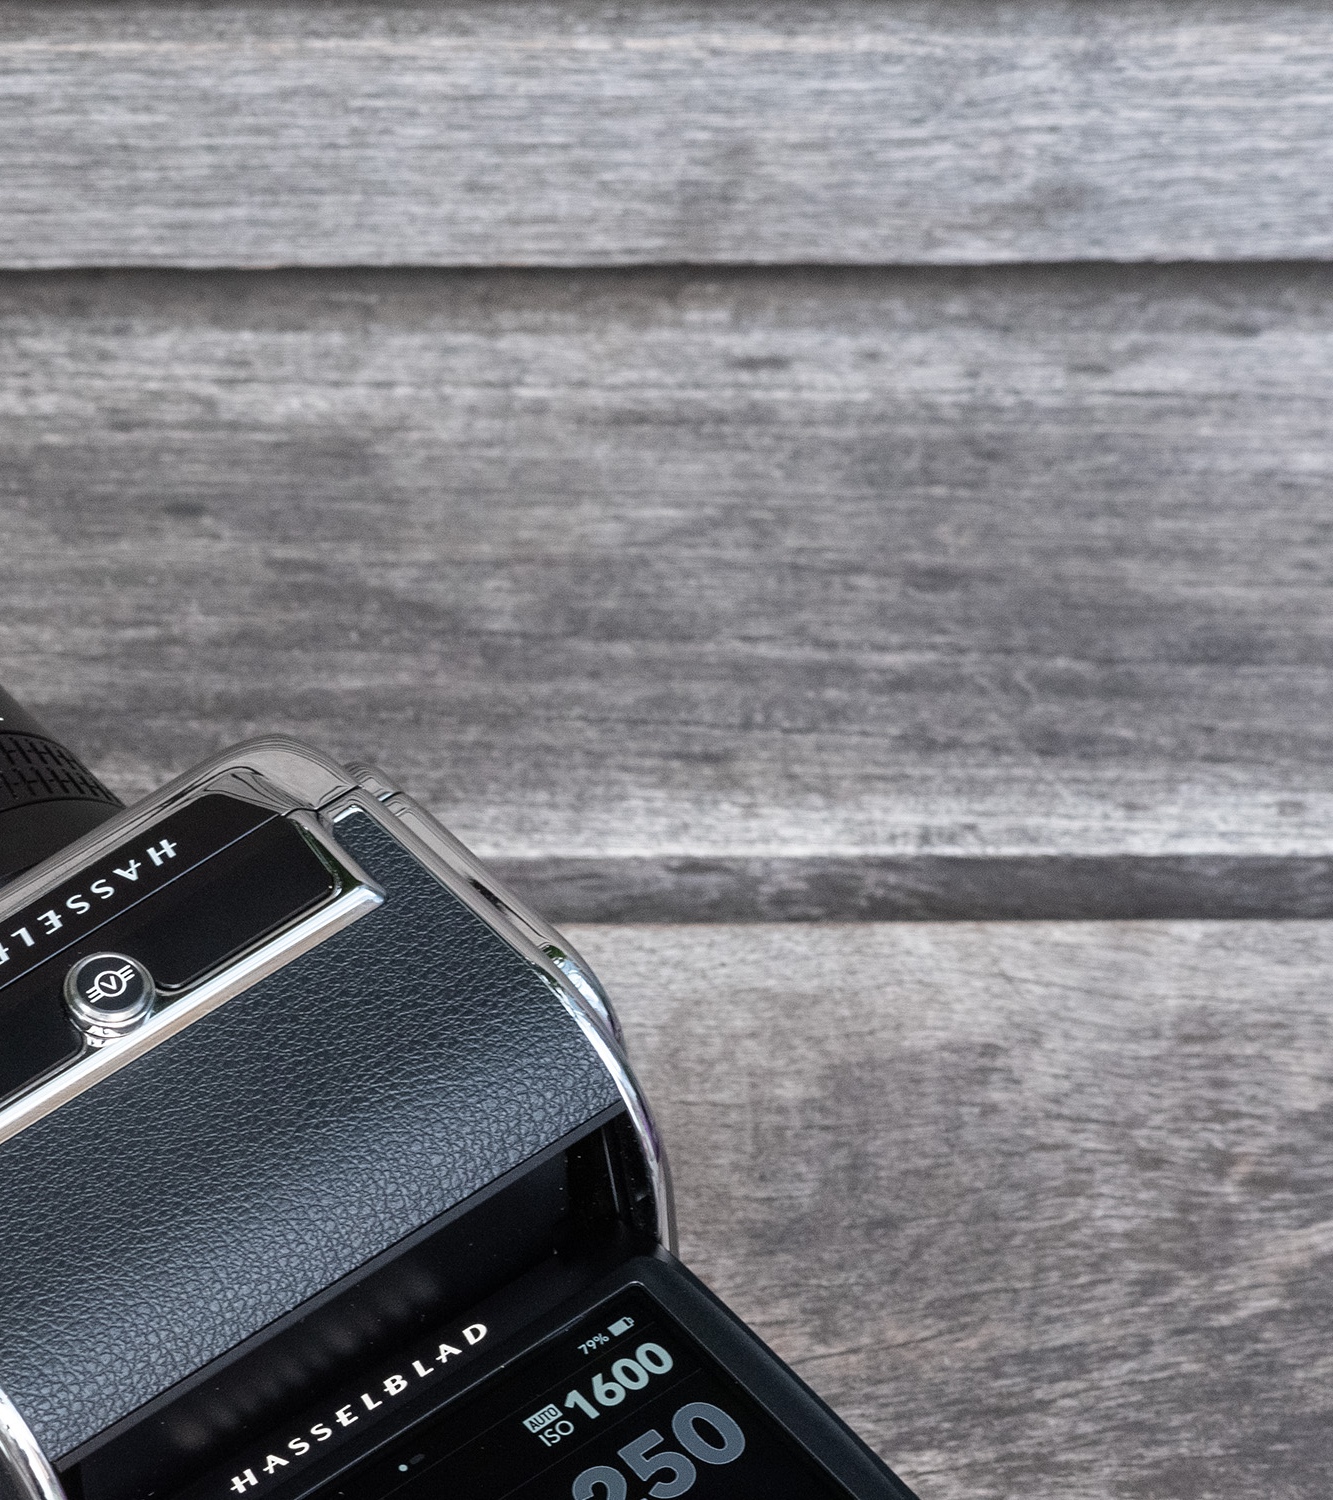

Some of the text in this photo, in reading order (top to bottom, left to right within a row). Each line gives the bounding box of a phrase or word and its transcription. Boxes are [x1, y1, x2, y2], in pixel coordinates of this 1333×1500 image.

[577, 1333, 610, 1355] 79%
[230, 1323, 488, 1494] HASSELBLAD
[527, 1406, 560, 1431] AUTO
[538, 1342, 674, 1447] ISO 1600
